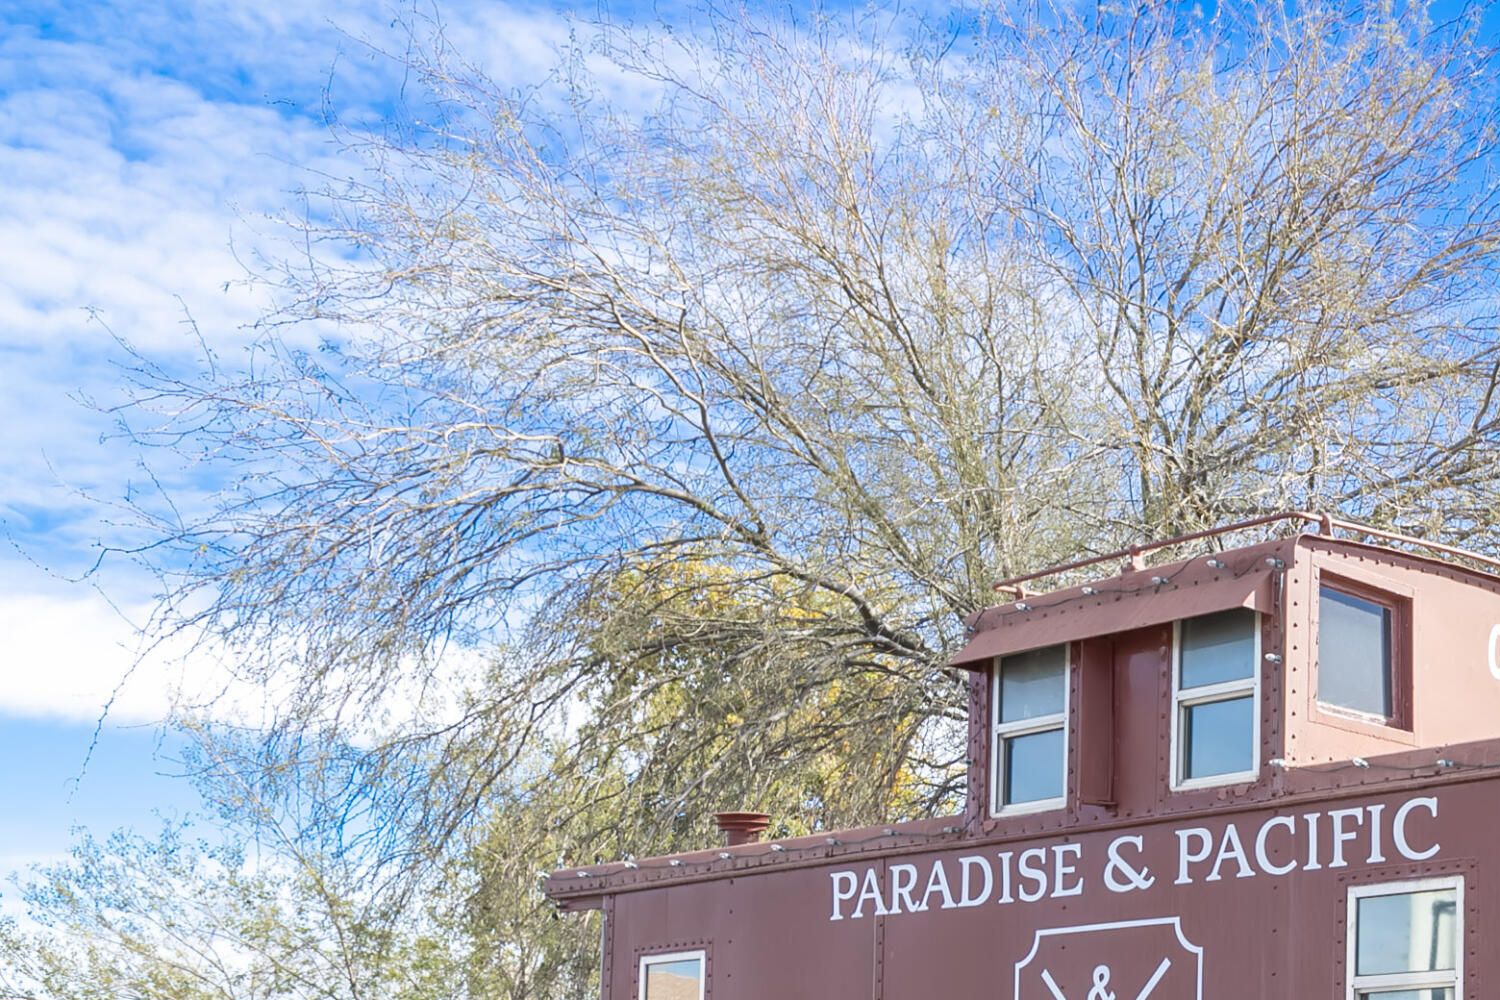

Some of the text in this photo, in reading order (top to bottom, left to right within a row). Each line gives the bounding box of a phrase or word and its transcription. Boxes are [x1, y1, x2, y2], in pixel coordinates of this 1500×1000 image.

[829, 797, 1441, 921] PARADISE & PACIFIC
